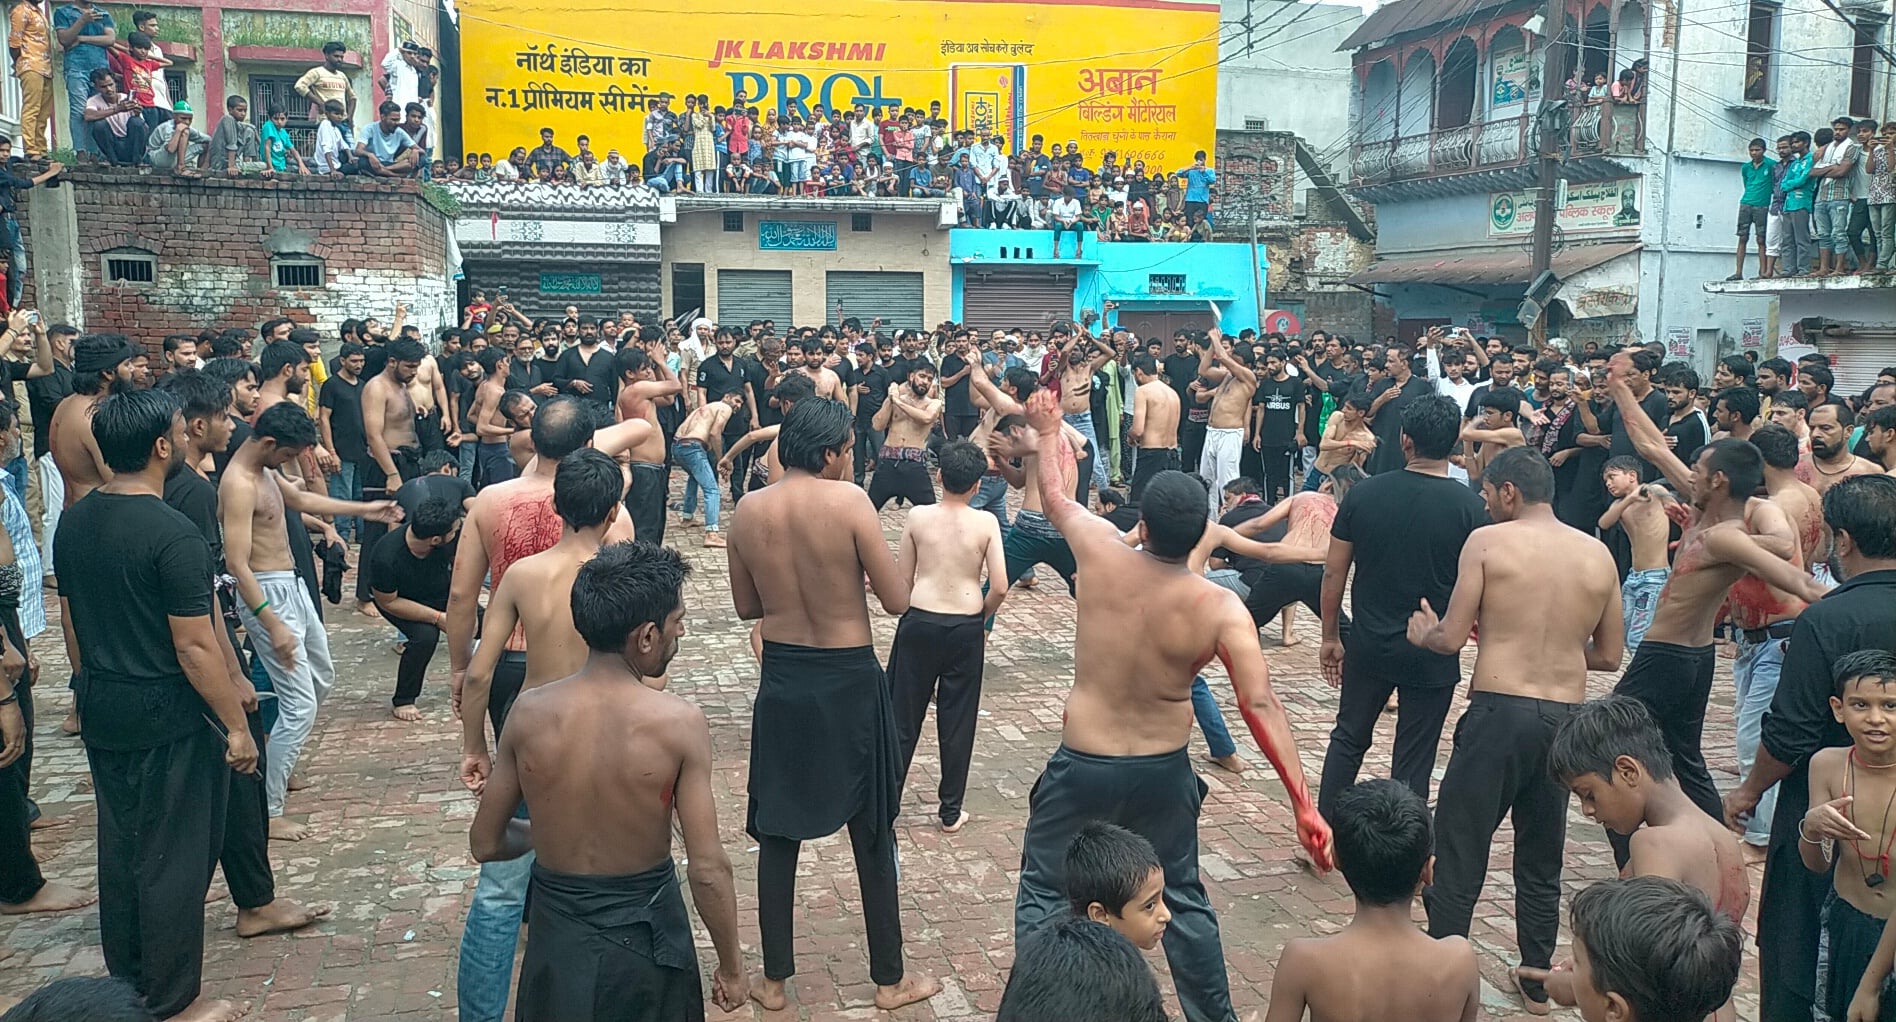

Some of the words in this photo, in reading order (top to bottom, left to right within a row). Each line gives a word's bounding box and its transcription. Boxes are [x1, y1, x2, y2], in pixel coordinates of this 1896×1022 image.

[516, 42, 556, 74] नॉर्थ
[560, 47, 614, 77] इंडिया
[619, 56, 651, 77] का
[708, 40, 745, 68] JK
[750, 41, 887, 62] LAKSHMI
[1078, 69, 1163, 96] अबान
[521, 81, 596, 112] प्रीमियम
[598, 83, 676, 114] सीमें
[1591, 204, 1617, 221] स्कूल
[699, 372, 706, 381] 3
[1266, 402, 1290, 410] AIRBUS
